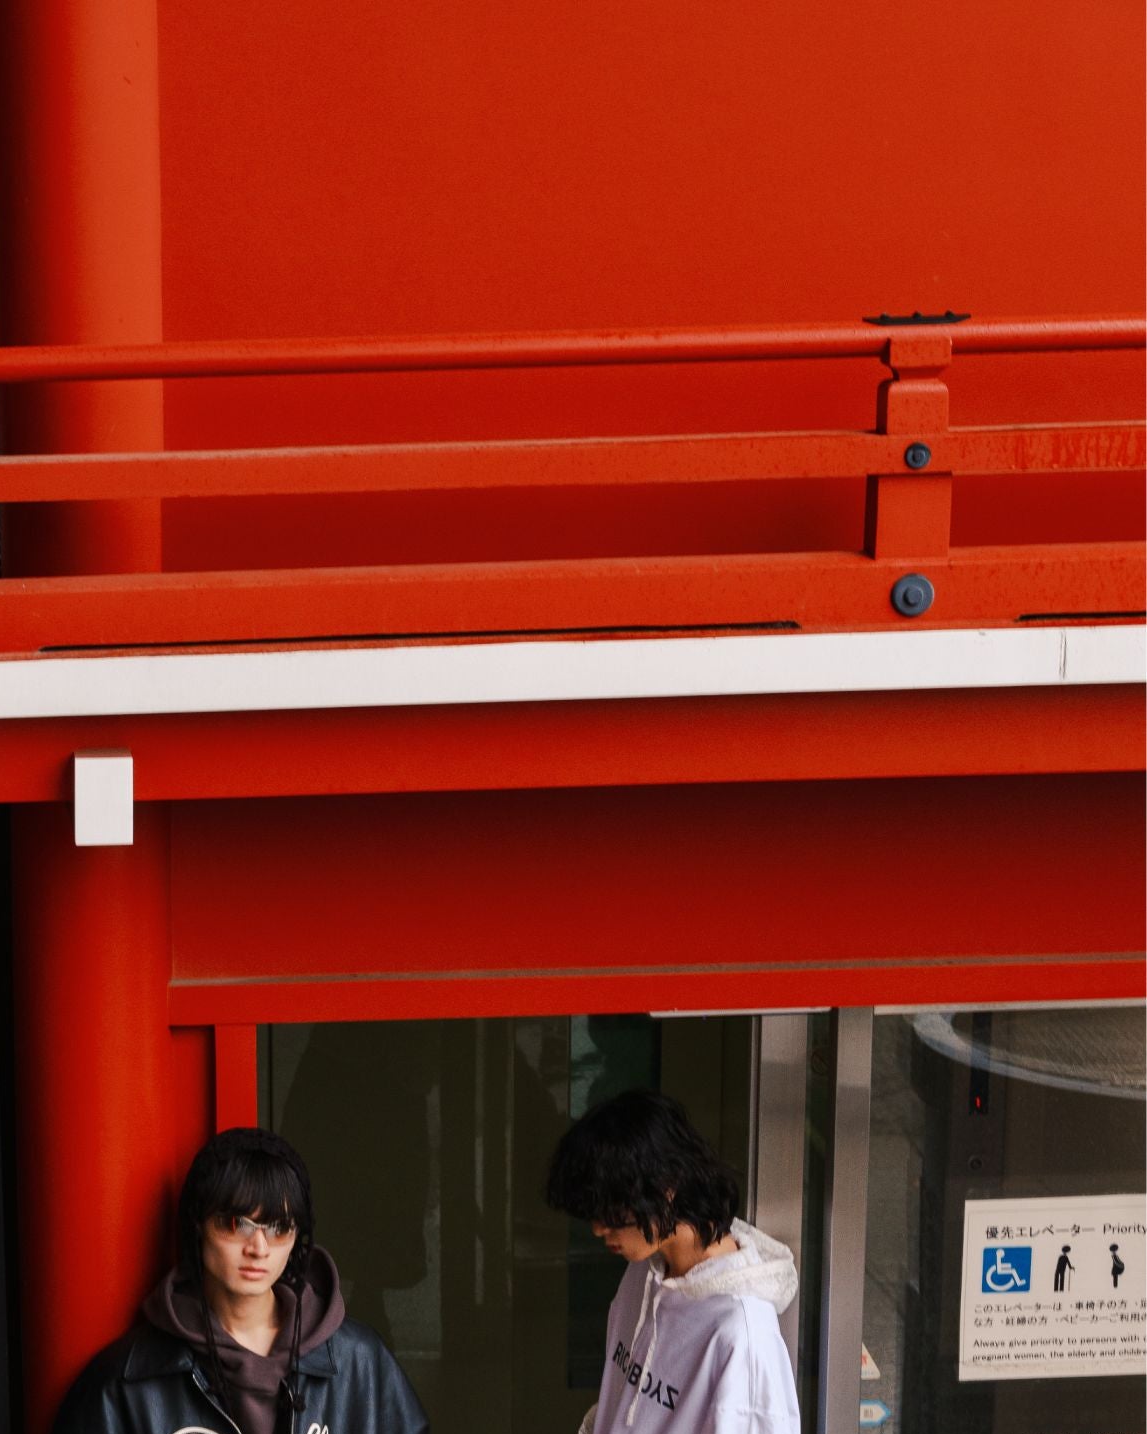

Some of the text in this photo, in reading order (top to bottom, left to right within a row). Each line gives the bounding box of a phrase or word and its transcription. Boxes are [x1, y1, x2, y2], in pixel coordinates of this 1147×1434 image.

[986, 1223, 1095, 1240] 優先エレベーター
[973, 1338, 1005, 1348] Always
[1009, 1338, 1027, 1348] give
[1030, 1337, 1064, 1346] priority
[1067, 1336, 1077, 1344] to
[1080, 1336, 1117, 1346] persons
[1120, 1334, 1140, 1343] with
[972, 1353, 1010, 1363] pregnant
[1050, 1350, 1064, 1358] the
[1067, 1349, 1096, 1359] elderly
[1099, 1349, 1115, 1357] and
